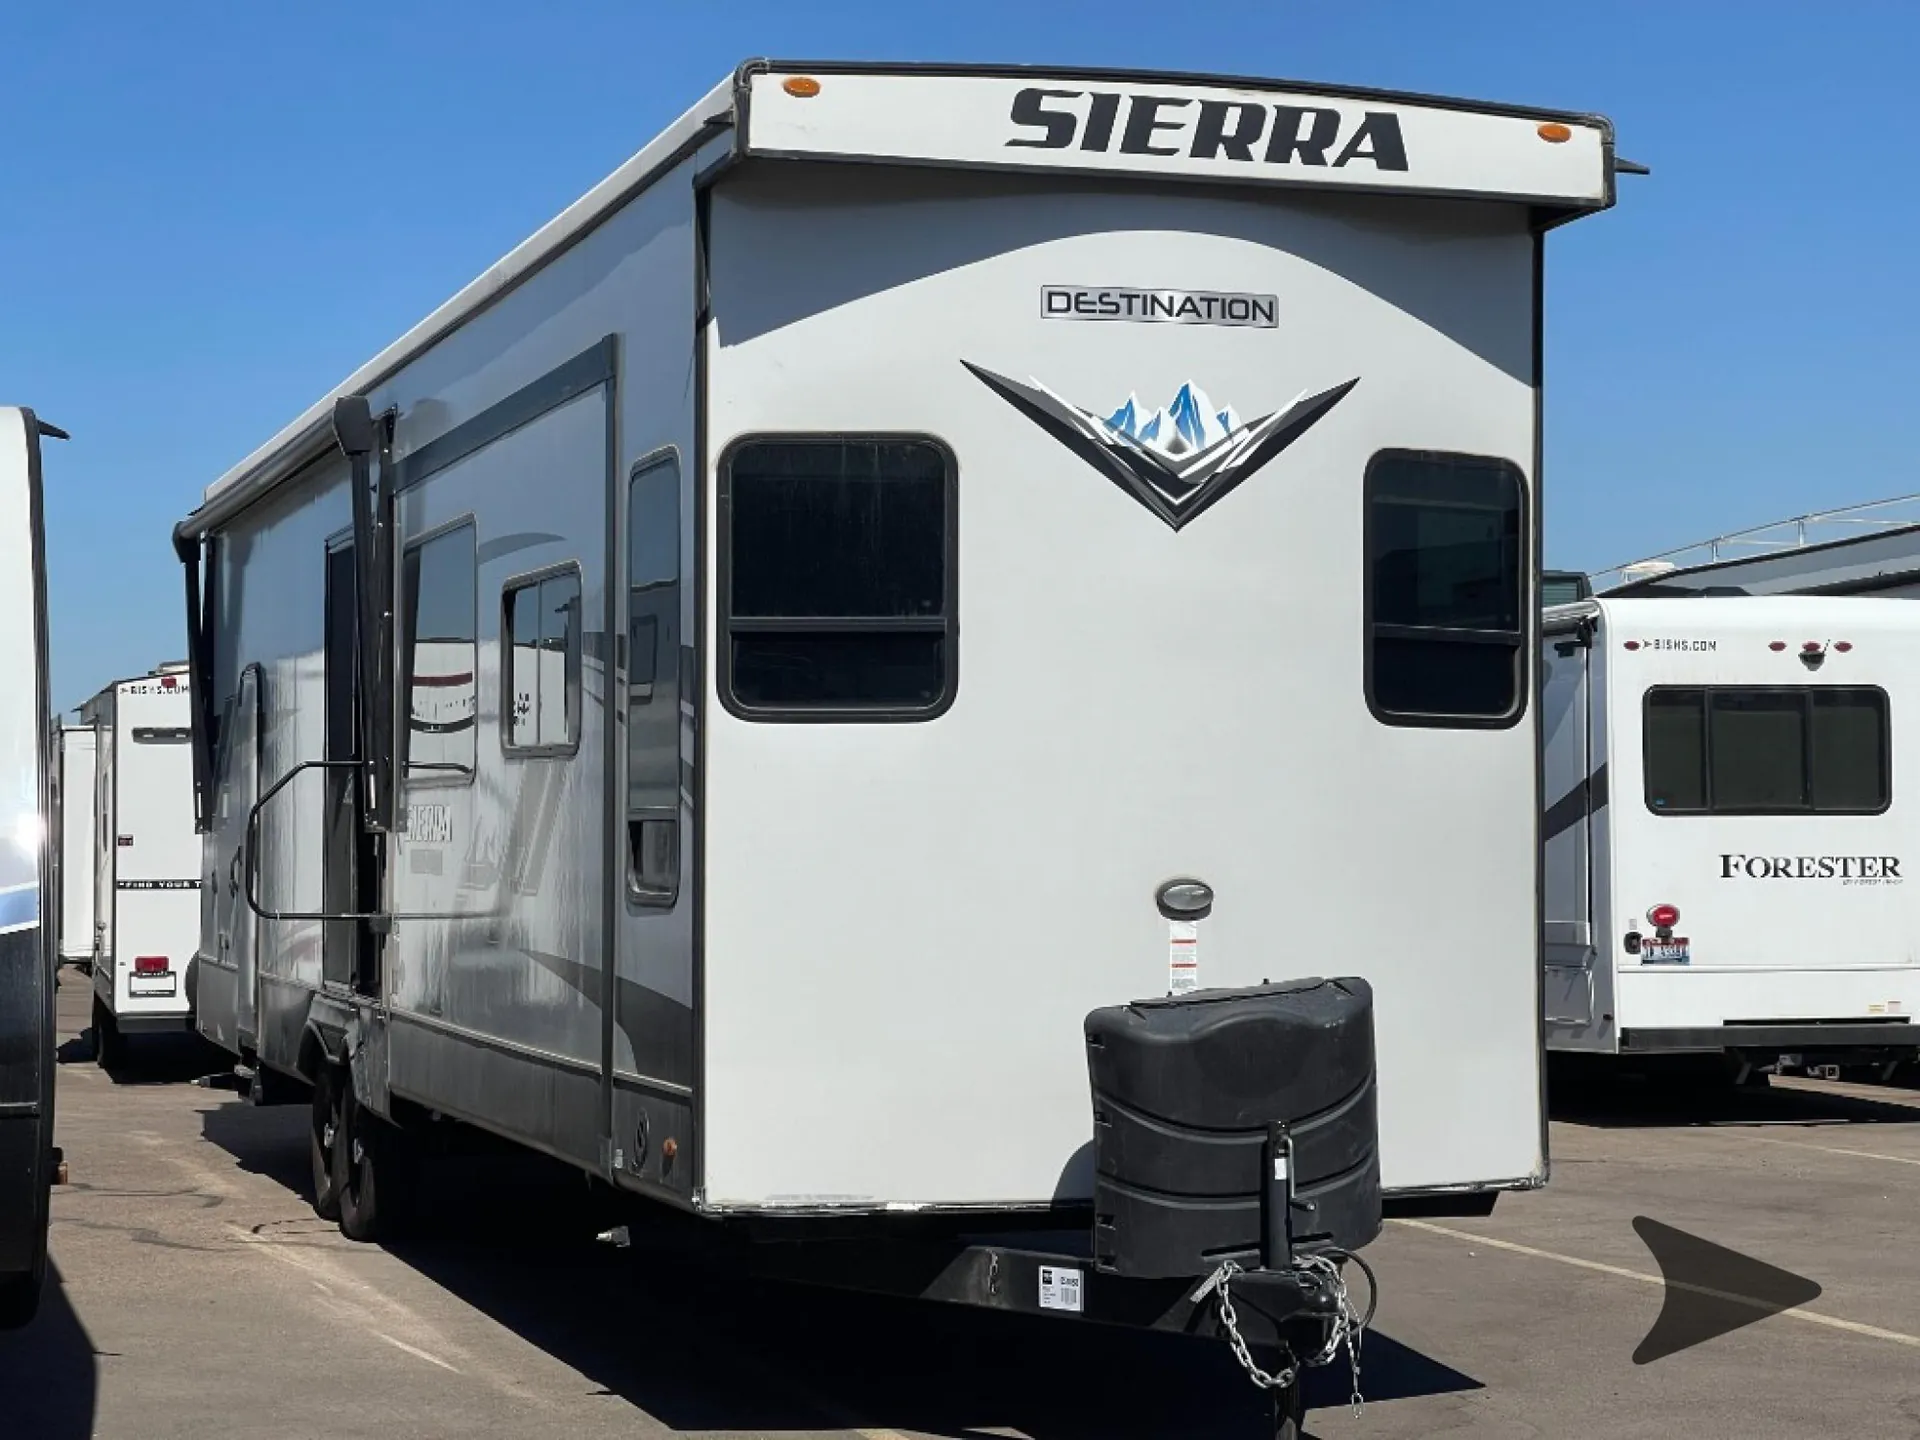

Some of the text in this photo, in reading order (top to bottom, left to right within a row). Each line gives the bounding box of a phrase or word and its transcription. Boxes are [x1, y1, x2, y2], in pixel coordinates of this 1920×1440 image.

[1003, 87, 1409, 172] SIERRA
[1046, 290, 1274, 323] DESTINATION
[1718, 854, 1903, 878] FORESTER
